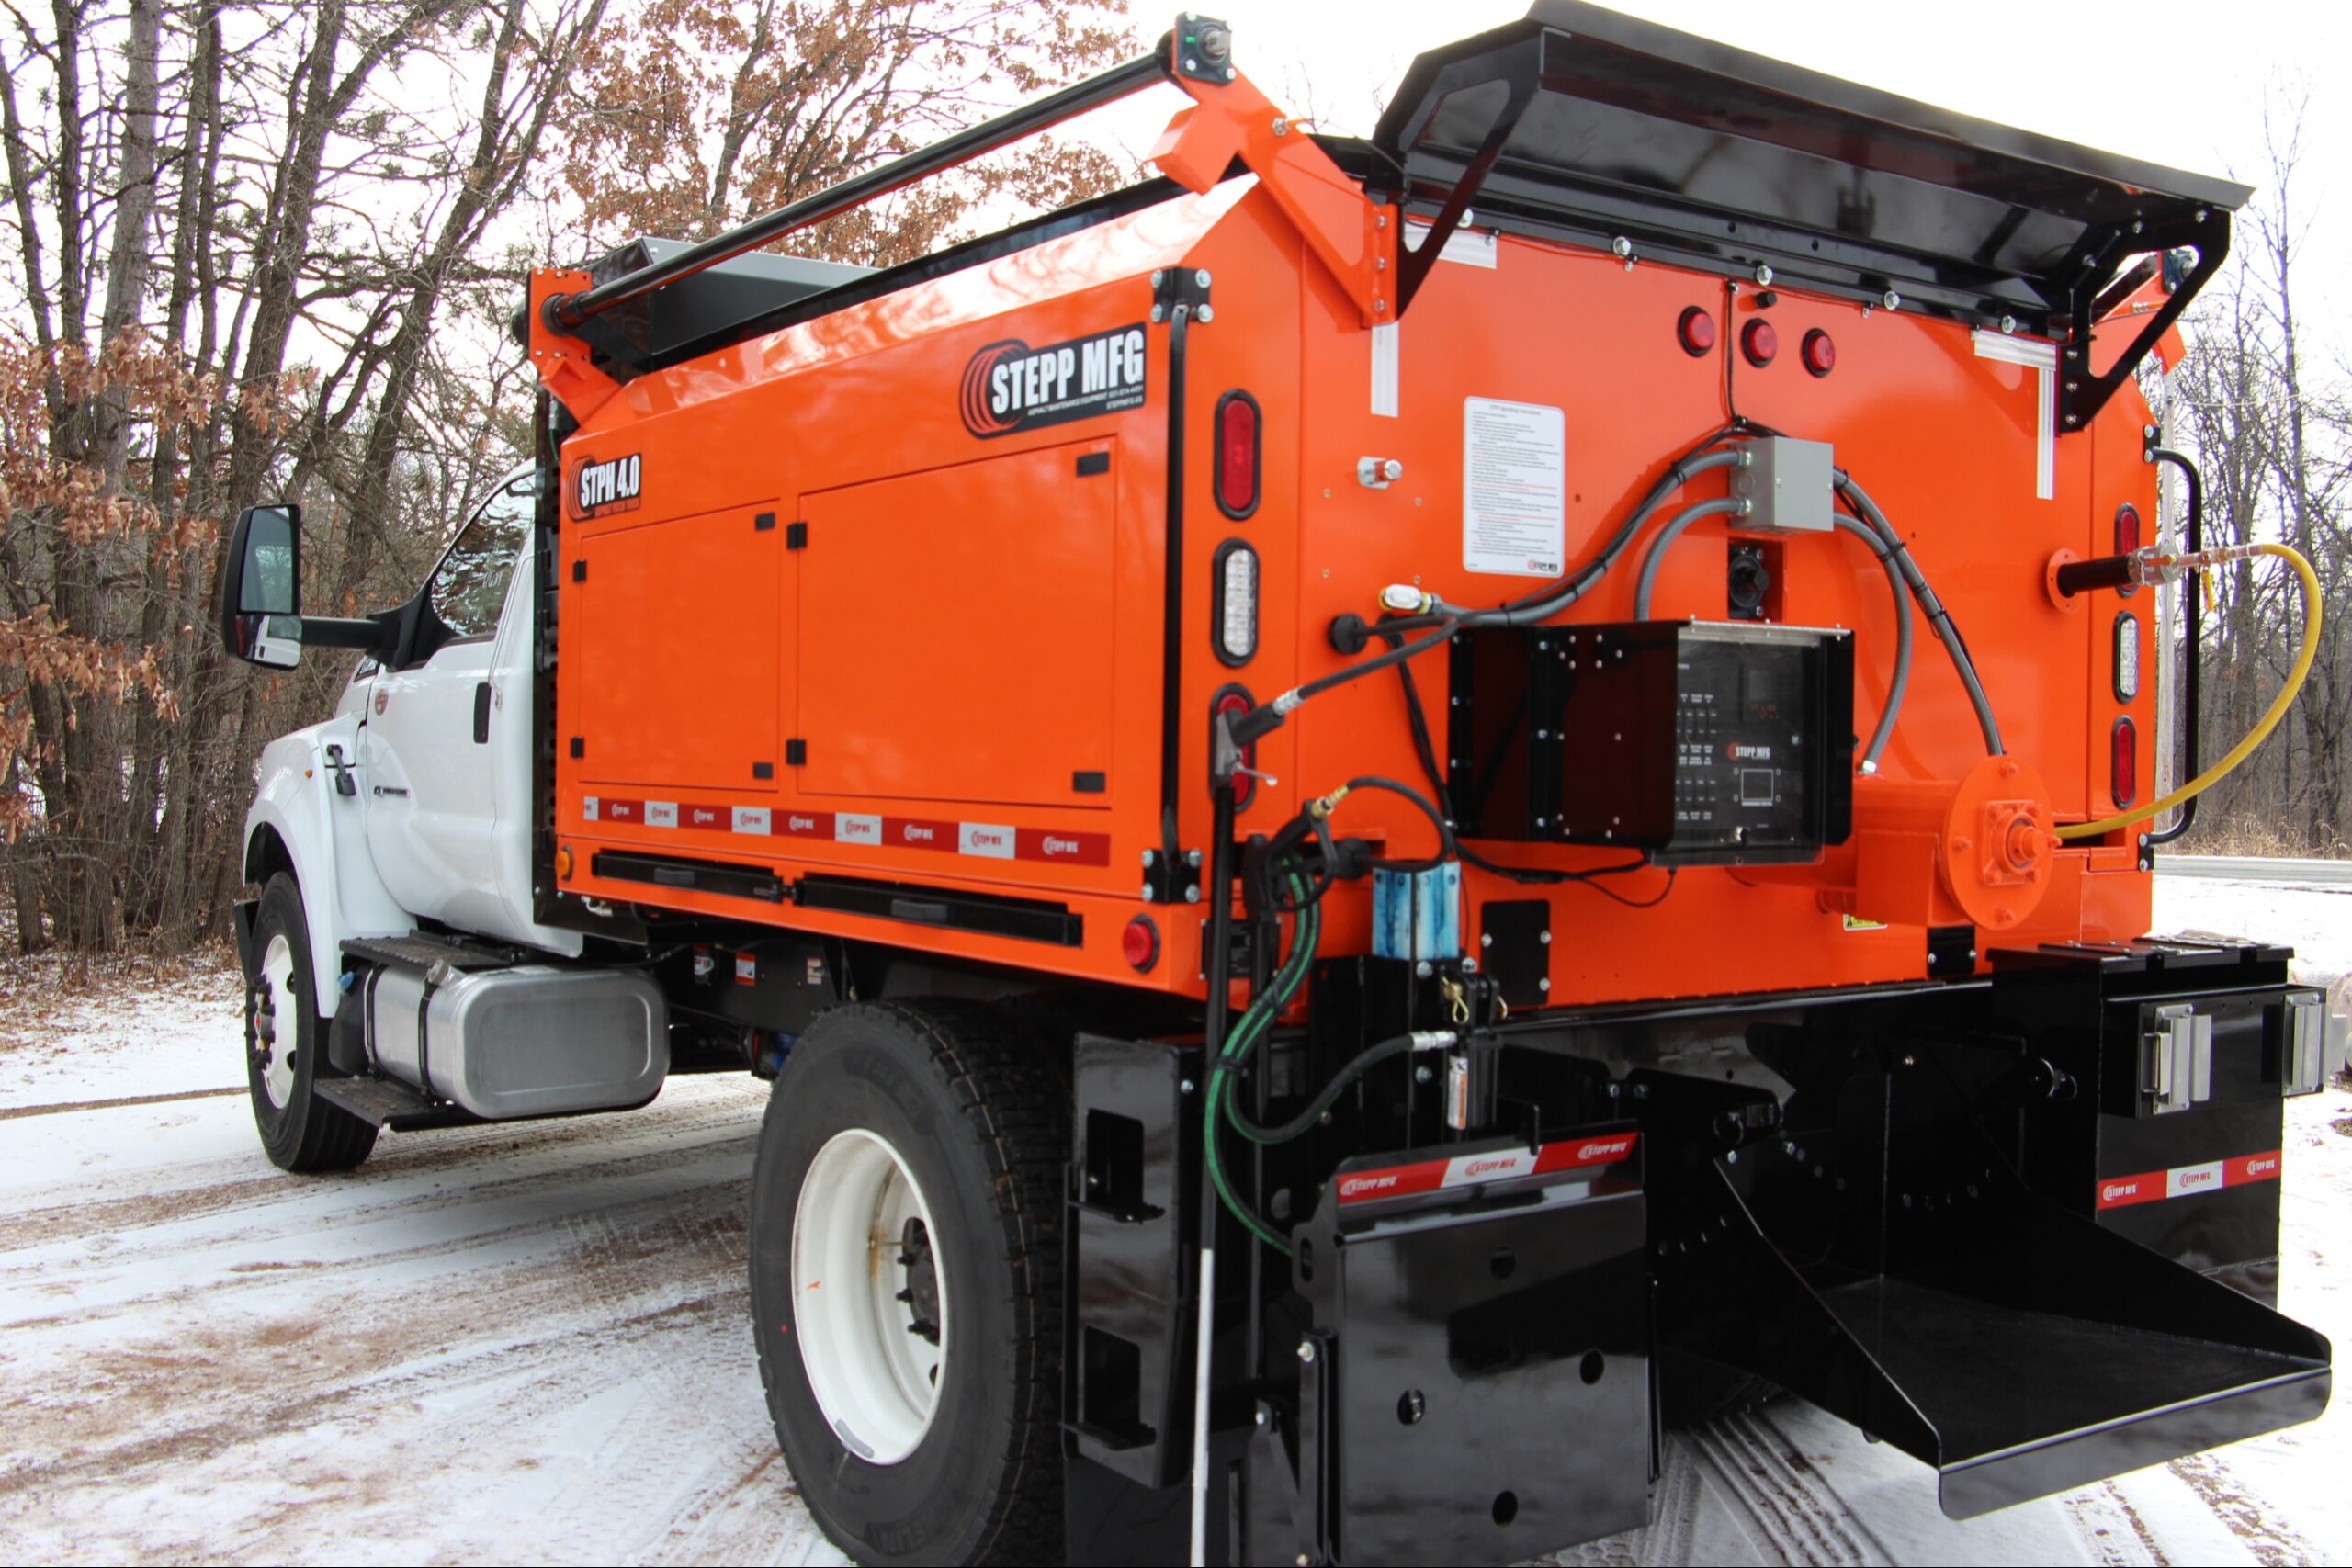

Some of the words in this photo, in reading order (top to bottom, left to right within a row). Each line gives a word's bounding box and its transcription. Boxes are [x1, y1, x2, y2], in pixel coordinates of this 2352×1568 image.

[991, 347, 1076, 414] STEPP
[1081, 329, 1145, 395] MFG
[581, 461, 616, 507] STPH
[616, 454, 640, 498] 4.0
[1735, 746, 1756, 757] STEPP
[1756, 747, 1770, 759] MFG
[2251, 1160, 2266, 1172] STEPP
[2266, 1158, 2275, 1169] MFG
[2185, 1174, 2199, 1185] STEPP
[2199, 1171, 2211, 1181] MFG
[2109, 1186, 2125, 1198] STEPP
[2125, 1184, 2137, 1195] MFG
